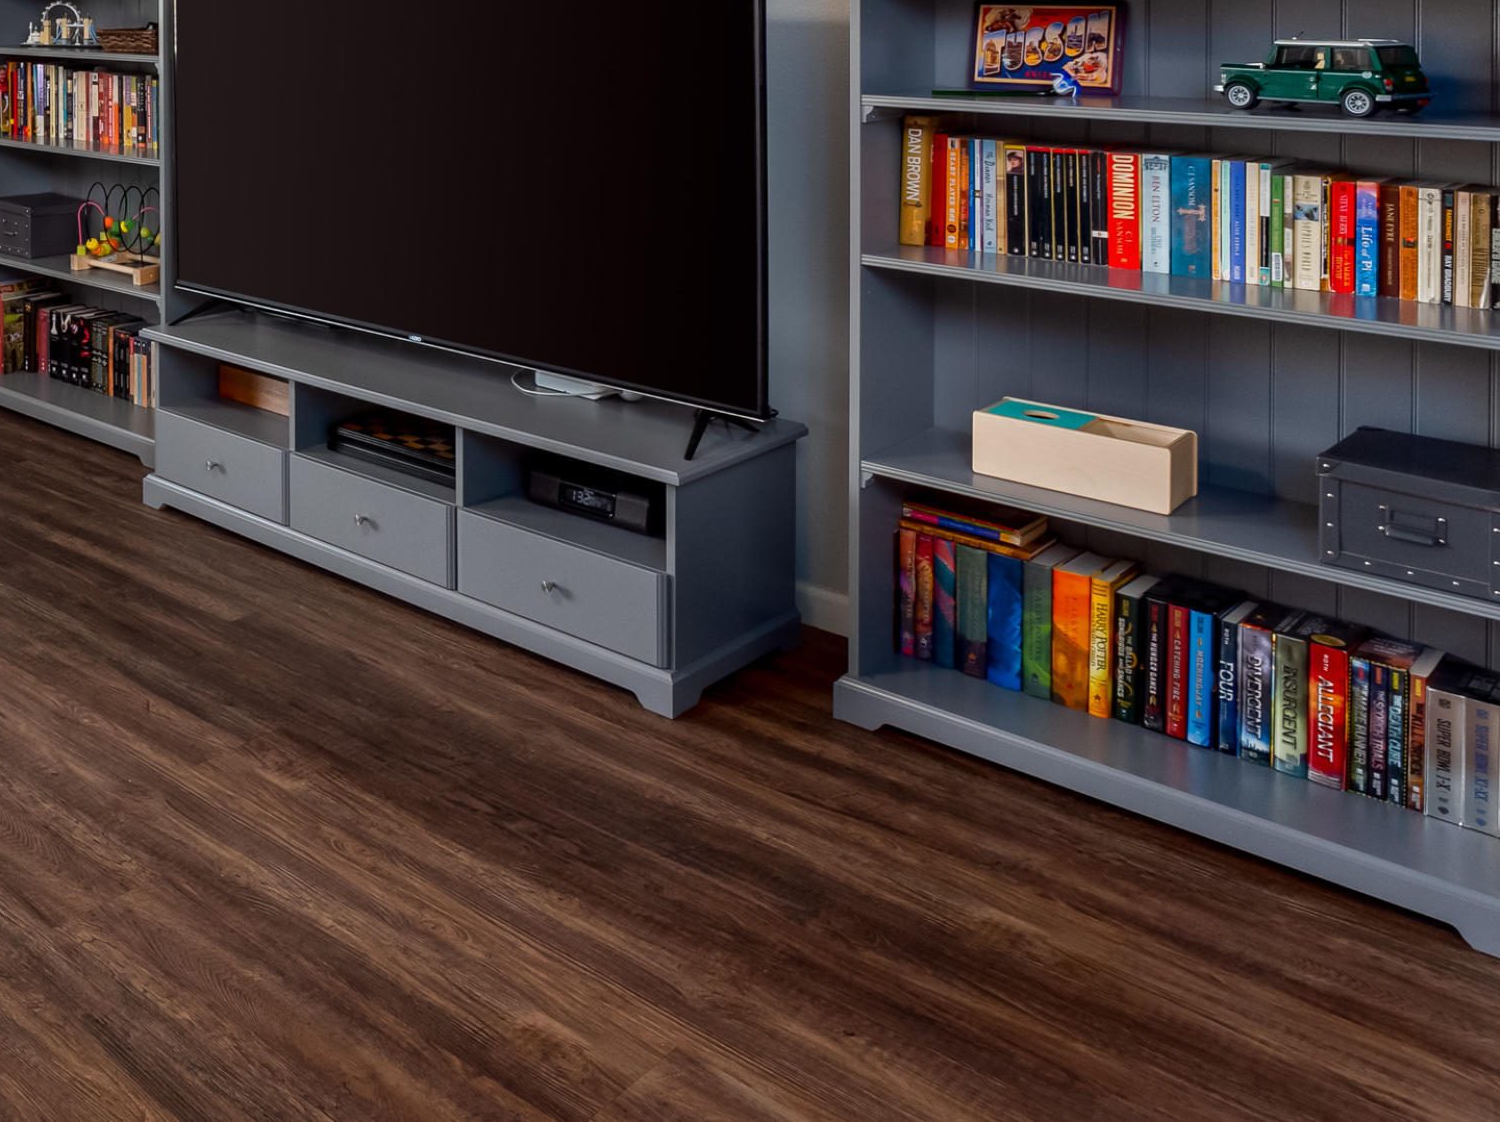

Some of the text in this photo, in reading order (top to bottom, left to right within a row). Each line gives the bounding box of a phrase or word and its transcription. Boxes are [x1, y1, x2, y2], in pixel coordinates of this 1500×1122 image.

[982, 10, 1110, 76] TUCSON
[908, 128, 923, 154] DAN
[906, 156, 922, 201] BROWN
[949, 151, 957, 223] READY PLAYER ONE
[984, 160, 995, 184] Dinner
[1112, 155, 1135, 220] DOMINION
[1151, 175, 1160, 223] BEN ELTON
[1187, 178, 1195, 206] SANSOM
[1361, 227, 1373, 248] Life
[1385, 203, 1394, 243] JANE EYRE
[1361, 248, 1370, 258] of
[1444, 255, 1452, 303] RAY BRADBURY
[1095, 602, 1108, 671] HARRY POTTER
[1117, 617, 1126, 657] SONGBIRDS
[1125, 646, 1133, 674] BALLAD
[1149, 642, 1158, 671] HUNGER
[1172, 639, 1182, 700] CATCHING FIRE
[1117, 668, 1125, 698] SNAKES
[1149, 671, 1157, 695] GAMES
[1195, 649, 1204, 707] MOCKINGJAY
[1219, 659, 1234, 702] FOUR
[1244, 654, 1263, 739] DIVERGENT
[1282, 665, 1298, 751] INSURGENT
[1317, 675, 1334, 763] ALLEGIANT
[1354, 694, 1368, 725] MAZE
[1372, 700, 1386, 738] SCORCH
[1354, 724, 1368, 766] RUNNER
[1388, 694, 1402, 768] THE DEATH CURE
[1411, 714, 1424, 744] KILL
[1436, 718, 1452, 748] SUPER
[1475, 724, 1489, 750] SUPER
[1371, 738, 1386, 770] TRIALS
[1436, 748, 1452, 773] BOWL
[1475, 752, 1489, 774] BOWL
